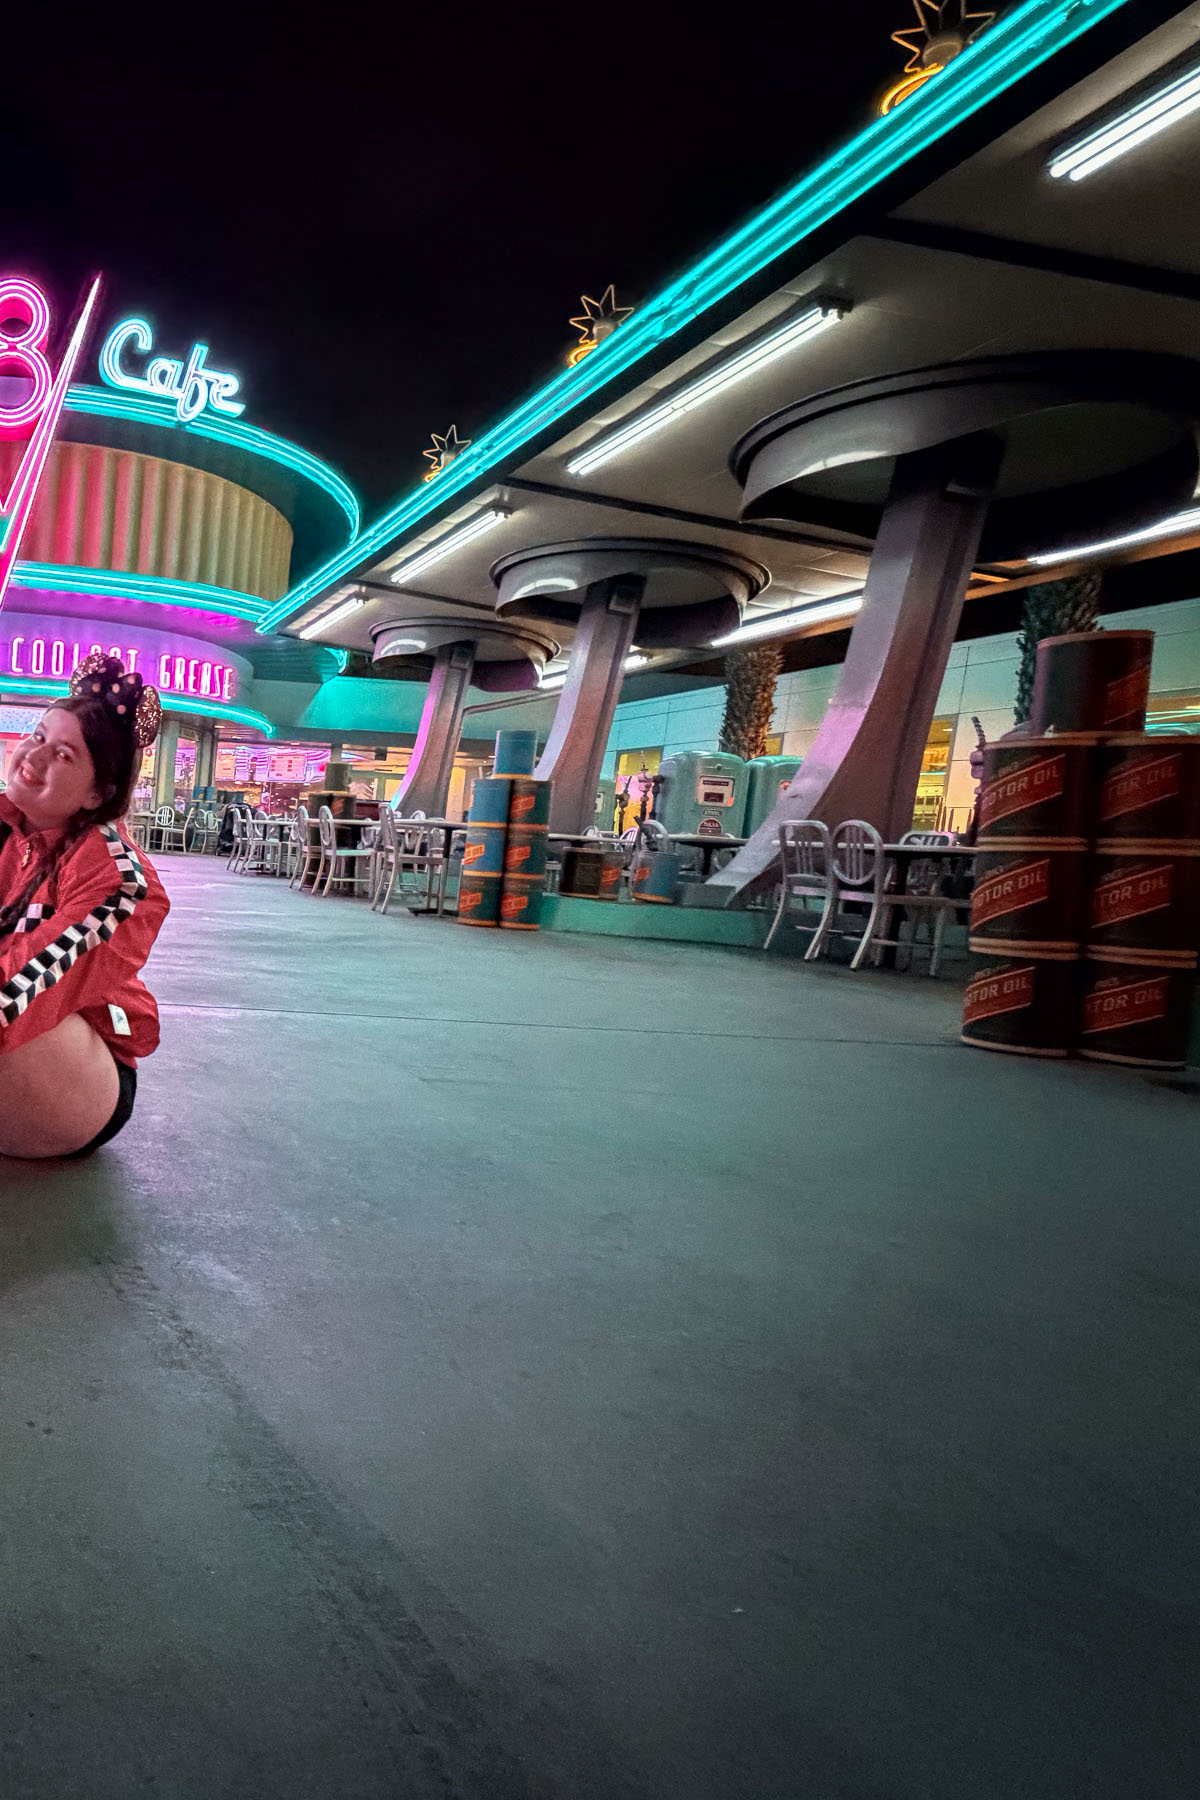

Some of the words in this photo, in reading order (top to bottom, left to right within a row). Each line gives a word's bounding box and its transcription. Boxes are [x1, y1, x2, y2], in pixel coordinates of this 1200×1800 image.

[98, 317, 246, 422] Cafe
[11, 637, 139, 676] COOLT
[158, 654, 234, 701] GREASE
[1031, 765, 1059, 786] OIL
[1018, 871, 1046, 891] OIL
[1138, 875, 1170, 896] OIL
[1003, 976, 1033, 995] OIL
